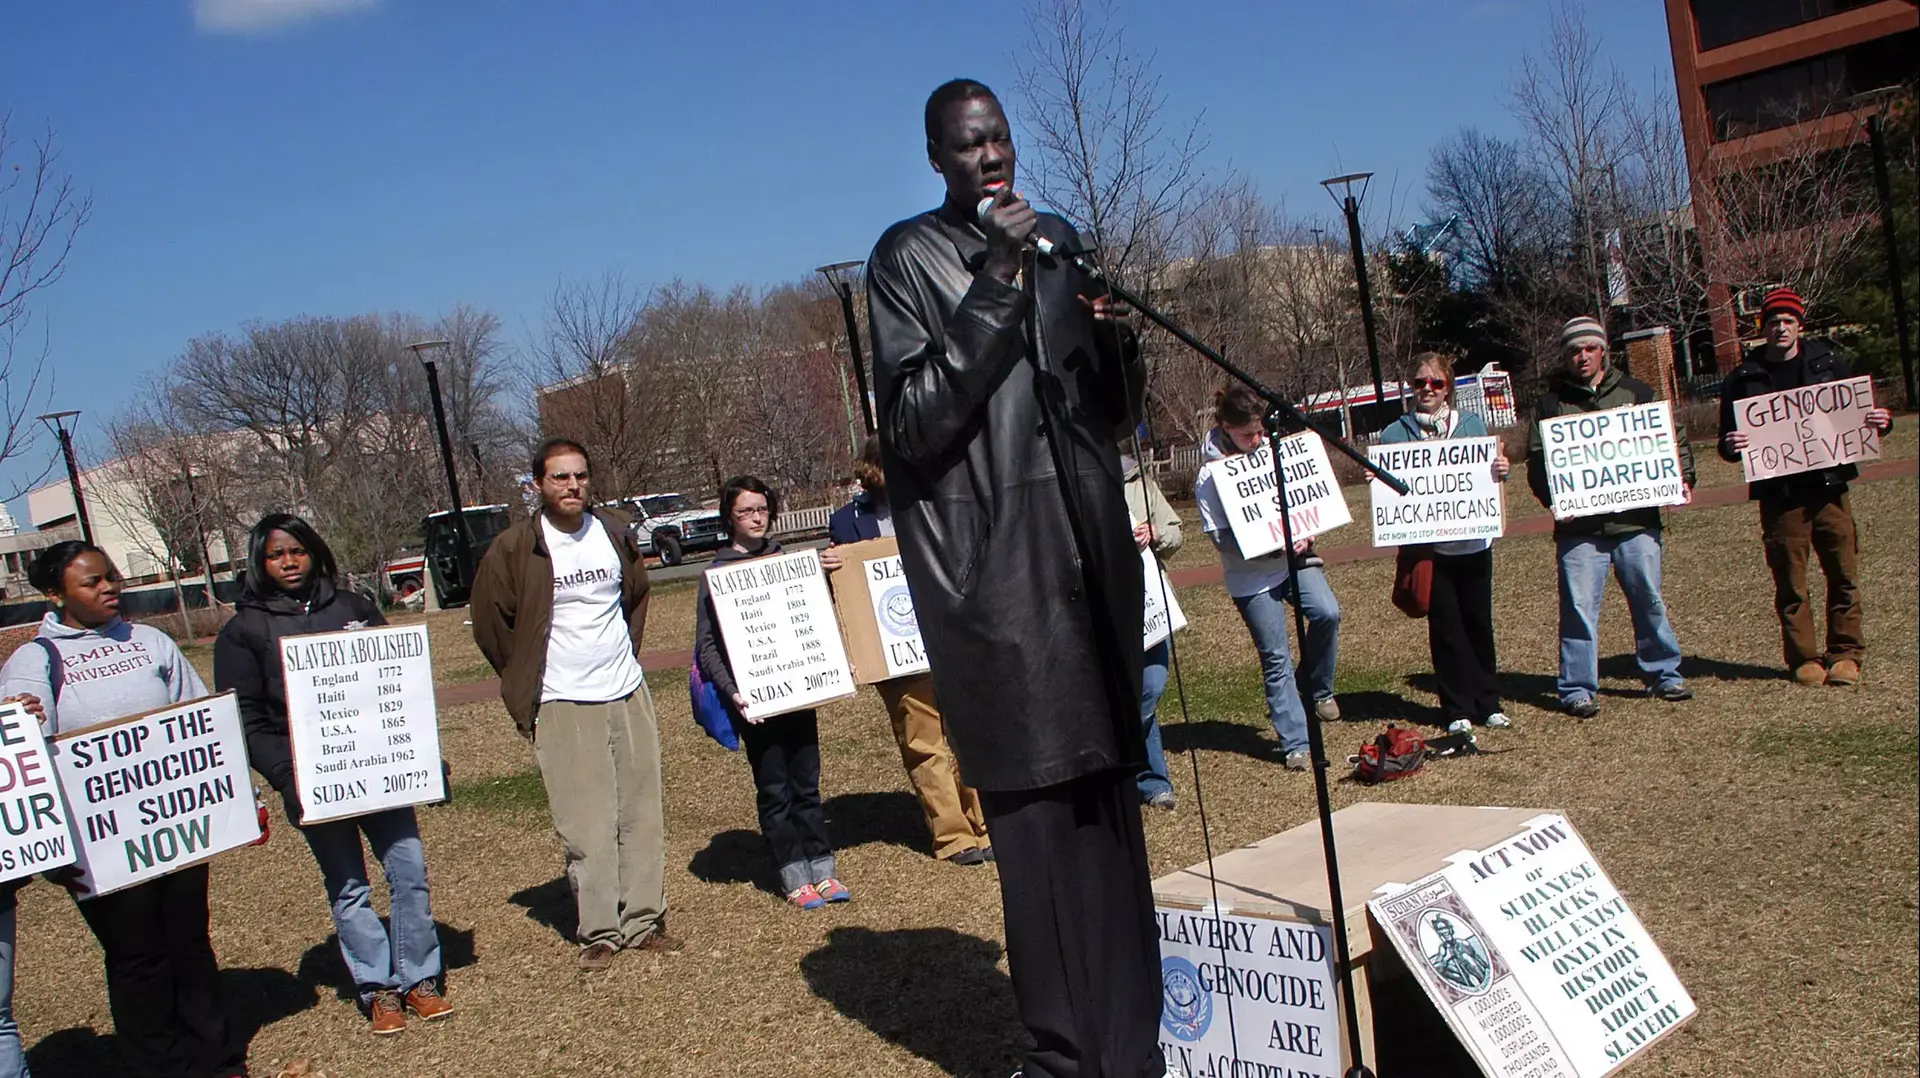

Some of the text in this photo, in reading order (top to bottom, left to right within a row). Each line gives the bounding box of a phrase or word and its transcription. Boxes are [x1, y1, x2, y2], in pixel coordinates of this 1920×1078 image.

[1746, 380, 1872, 427] GENOCIDE
[1550, 408, 1662, 444] STOP THE
[1794, 418, 1814, 441] IS
[1225, 450, 1269, 477] STOP
[1551, 432, 1670, 468] GENOCIDE
[1748, 426, 1878, 476] FOREVER
[1552, 457, 1677, 494] IN DARFUR
[1242, 503, 1262, 523] IN
[1376, 497, 1500, 526] BLACK AFRICANS.
[1559, 483, 1679, 512] CALL CONGRESS NOW
[1378, 533, 1390, 541] ACT
[1392, 532, 1407, 540] NOW
[1418, 530, 1434, 538] STOP
[1436, 527, 1467, 537] GENOCIDE
[1477, 524, 1499, 533] SUDAN
[554, 567, 607, 588] sudan
[711, 555, 817, 597] SLAVERY ABOLISHED
[734, 584, 804, 608] England 1772
[740, 599, 806, 621] Haiti 1804
[745, 613, 810, 635] Mexico 1829
[748, 626, 814, 649] U.S.A. 1865
[63, 641, 146, 667] EMPLE
[286, 631, 423, 672] SLAVERY ABOLISHED
[748, 653, 826, 679] Saudi Arabia 1962
[751, 640, 821, 663] Brazil 1888
[312, 665, 402, 688] England 1772
[317, 683, 401, 704] Haiti 1804
[750, 669, 840, 704] SUDAN 2007??
[319, 700, 403, 722] Mexico 1829
[321, 716, 406, 738] U.S.A. 1865
[71, 708, 214, 769] STOP THE
[322, 732, 412, 755] Brazil 1888
[85, 742, 224, 803] GENOCIDE
[315, 749, 415, 774] Saudi Arabia 1962
[313, 769, 428, 805] SUDAN 2007??
[86, 775, 234, 842] IN SUDAN
[20, 835, 65, 867] NOW
[124, 814, 212, 873] NOW
[1469, 820, 1567, 883] ACT NOW
[1500, 861, 1596, 921] SUDANESE
[1525, 866, 1543, 882] or
[1387, 895, 1420, 919] SUDAN
[1522, 885, 1599, 936] BLACKS
[1268, 926, 1325, 962] AND
[1520, 896, 1627, 963] WILL EXIST
[1552, 923, 1625, 976] ONLY IN
[1197, 962, 1325, 1011] GENOCIDE
[1561, 941, 1640, 1000] HISTORY
[1584, 966, 1648, 1015] BOOKS
[1479, 1001, 1522, 1031] MURDERED
[1601, 985, 1660, 1037] ABOUT
[1268, 1020, 1323, 1057] ARE
[1501, 1030, 1538, 1058] DISPLACED
[1604, 1000, 1680, 1064] SLAVERY
[1503, 1042, 1550, 1077] THOUSANDS
